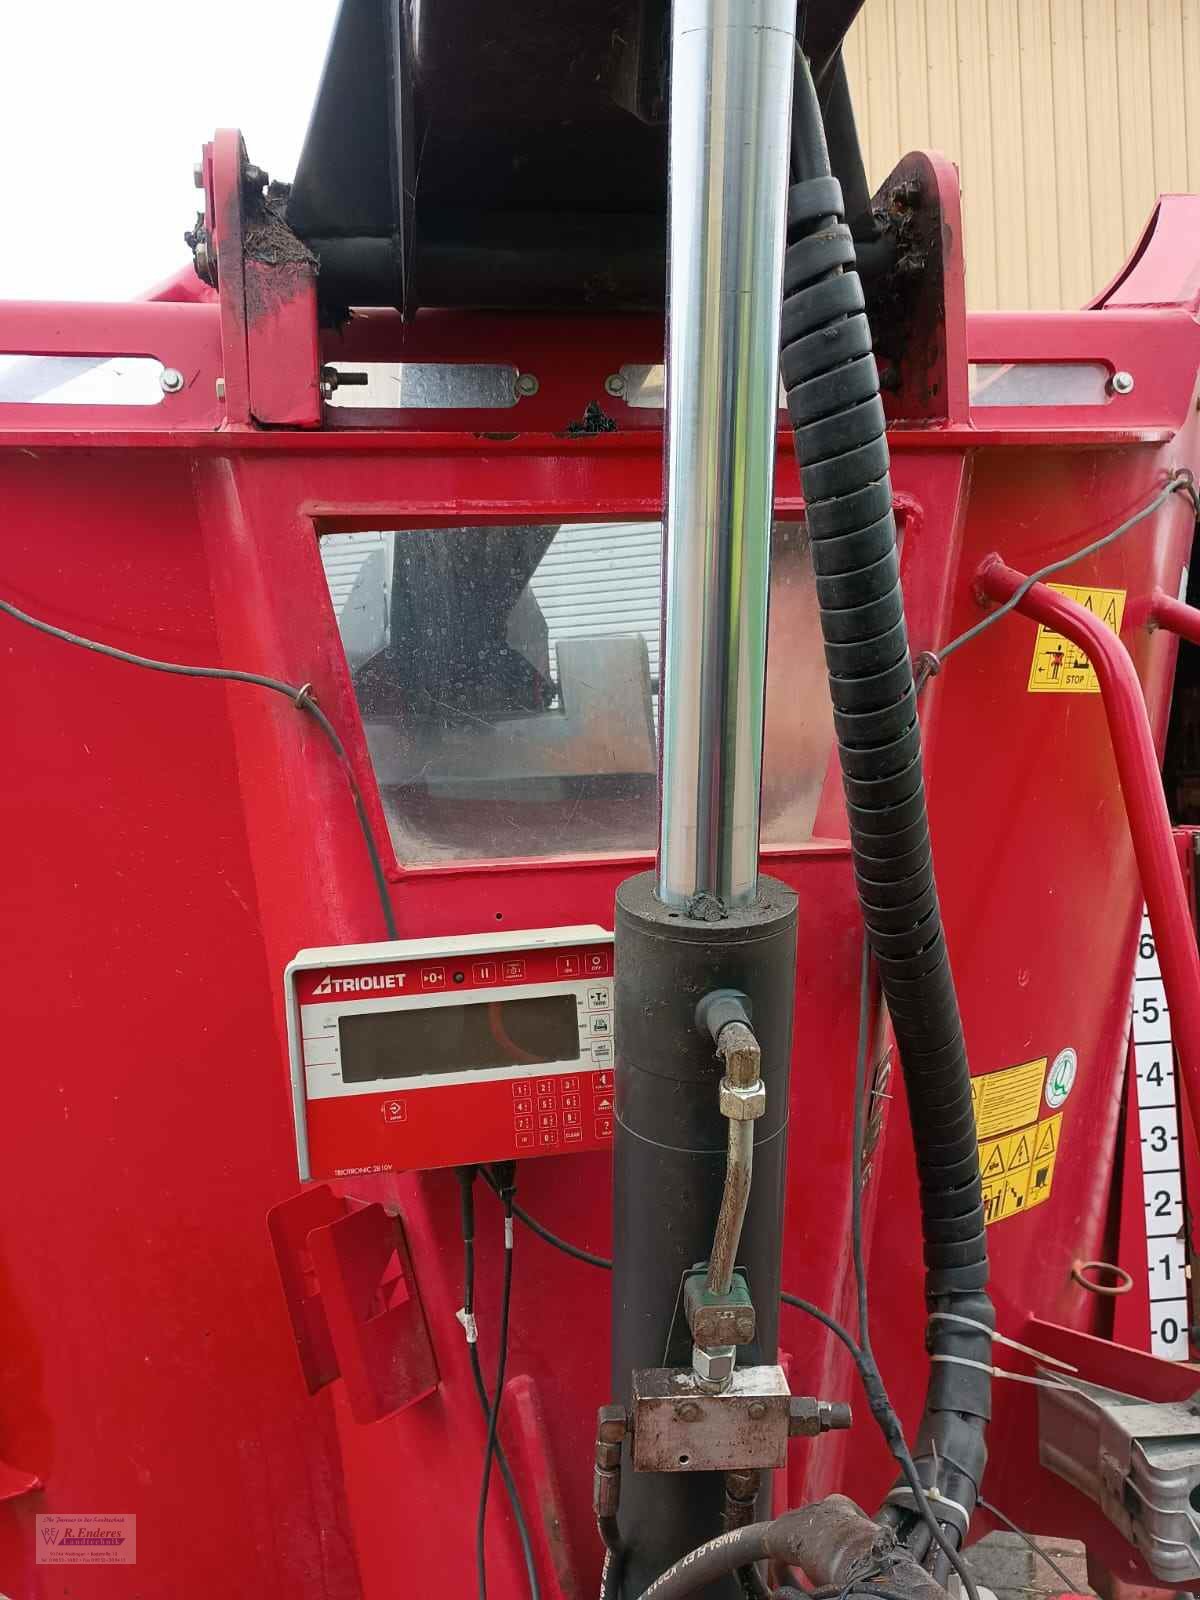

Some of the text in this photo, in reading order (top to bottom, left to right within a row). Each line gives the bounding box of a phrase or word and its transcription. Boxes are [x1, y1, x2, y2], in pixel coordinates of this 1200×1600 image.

[1066, 675, 1085, 684] STOP
[1138, 933, 1155, 959] 6
[331, 973, 406, 995] TRIOLIET
[1142, 997, 1160, 1024] 5
[1146, 1061, 1164, 1088] 4
[1149, 1125, 1168, 1153] 3
[1153, 1190, 1172, 1217] 2
[1158, 1255, 1171, 1281] 1
[1159, 1319, 1179, 1345] 0
